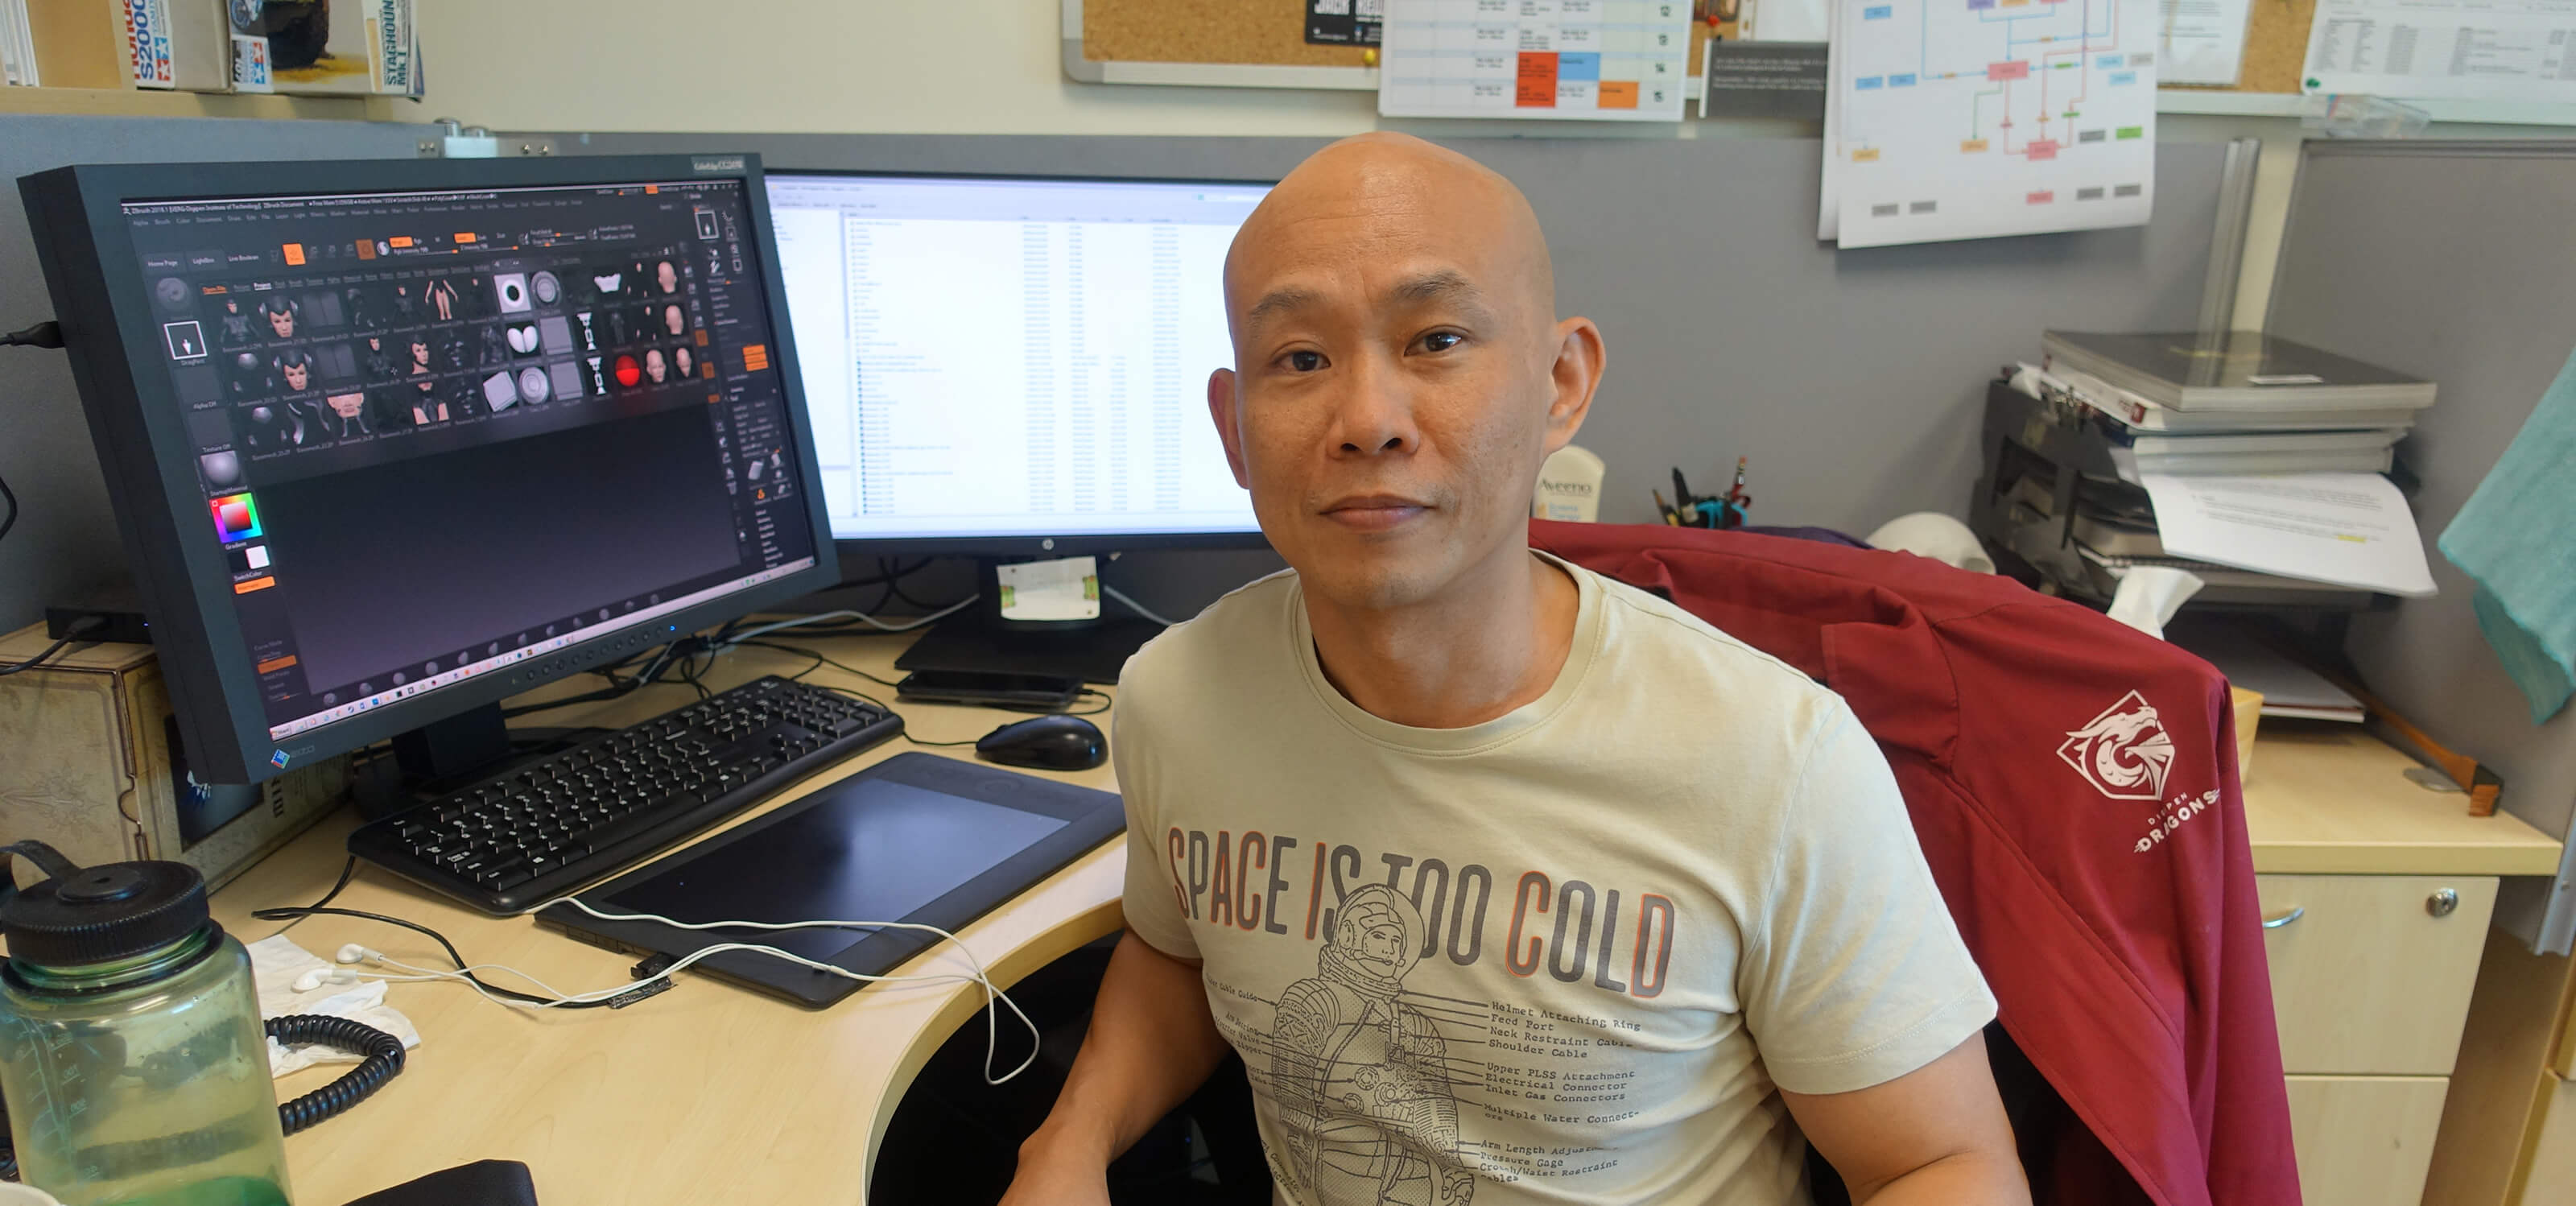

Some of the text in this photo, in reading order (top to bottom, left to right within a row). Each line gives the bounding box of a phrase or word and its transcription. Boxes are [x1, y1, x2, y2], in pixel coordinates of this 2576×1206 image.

[1169, 827, 1675, 998] SPACE IS TOO COLD
[1491, 1014, 1554, 1031] Feed Port
[1492, 1002, 1641, 1032] Helmet Attaching Ring
[1490, 1026, 1518, 1039] Neck
[1525, 1033, 1589, 1047] Restraint
[1488, 1039, 1587, 1059] Shoulder Cable
[1487, 1062, 1636, 1080] Upper PLSS Attachment
[1485, 1073, 1628, 1092] Electrical Connector
[1485, 1084, 1625, 1102] Inlet Gas Connectors
[1484, 1102, 1640, 1124] Multiple Water Connect-
[1480, 1139, 1501, 1150] Arm
[1506, 1143, 1545, 1156] Length
[1480, 1151, 1563, 1168] Pressure Gage
[1562, 1159, 1618, 1177] Restraint
